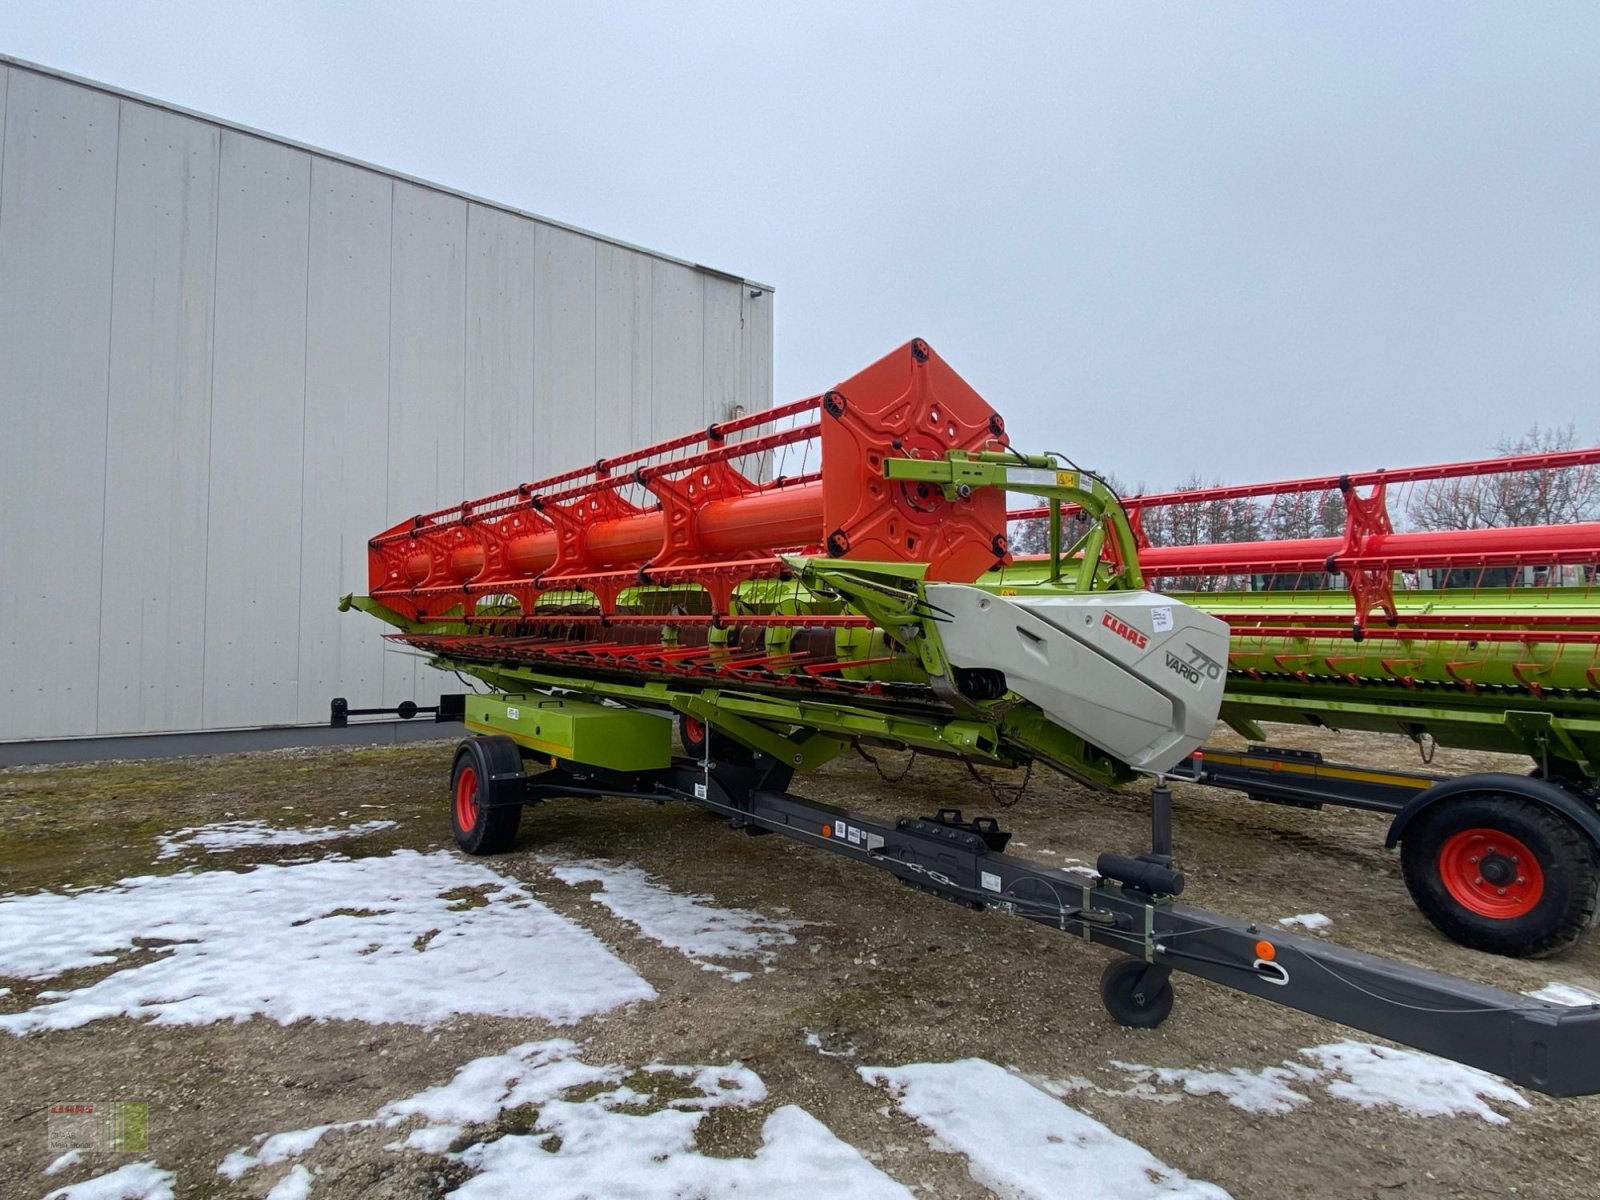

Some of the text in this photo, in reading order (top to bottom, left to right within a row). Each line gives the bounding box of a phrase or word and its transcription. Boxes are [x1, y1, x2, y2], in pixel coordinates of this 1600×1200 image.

[1102, 613, 1147, 650] CLAAS
[1165, 653, 1200, 685] VARIO
[1188, 648, 1221, 680] 770
